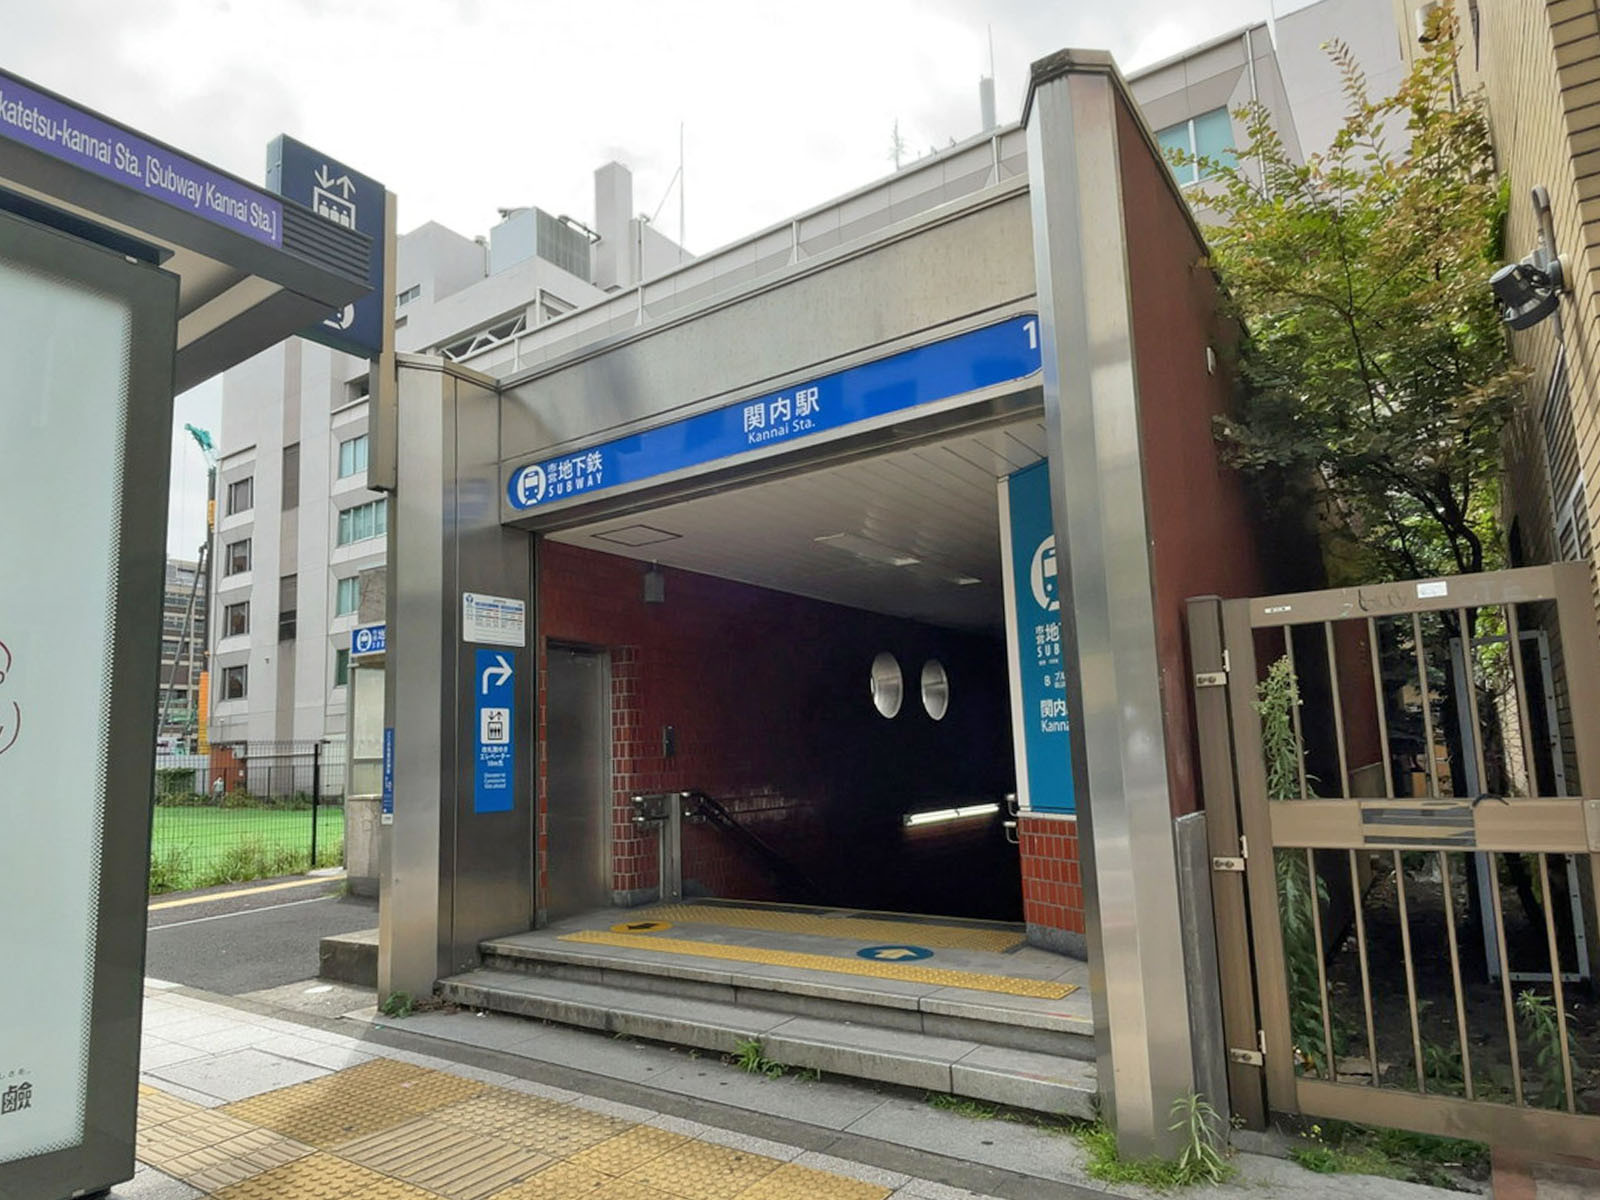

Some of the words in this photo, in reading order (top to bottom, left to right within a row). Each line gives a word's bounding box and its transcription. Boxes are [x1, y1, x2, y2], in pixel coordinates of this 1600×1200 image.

[114, 141, 142, 178] Sta.
[145, 154, 203, 208] [Subway
[205, 181, 248, 223] Kannai
[249, 201, 277, 241] Sta.]
[1022, 320, 1038, 350] 1
[743, 386, 820, 433] 関内駅
[748, 422, 789, 444] Kannai
[792, 418, 816, 433] Sta.
[548, 471, 603, 498] SUBWAY
